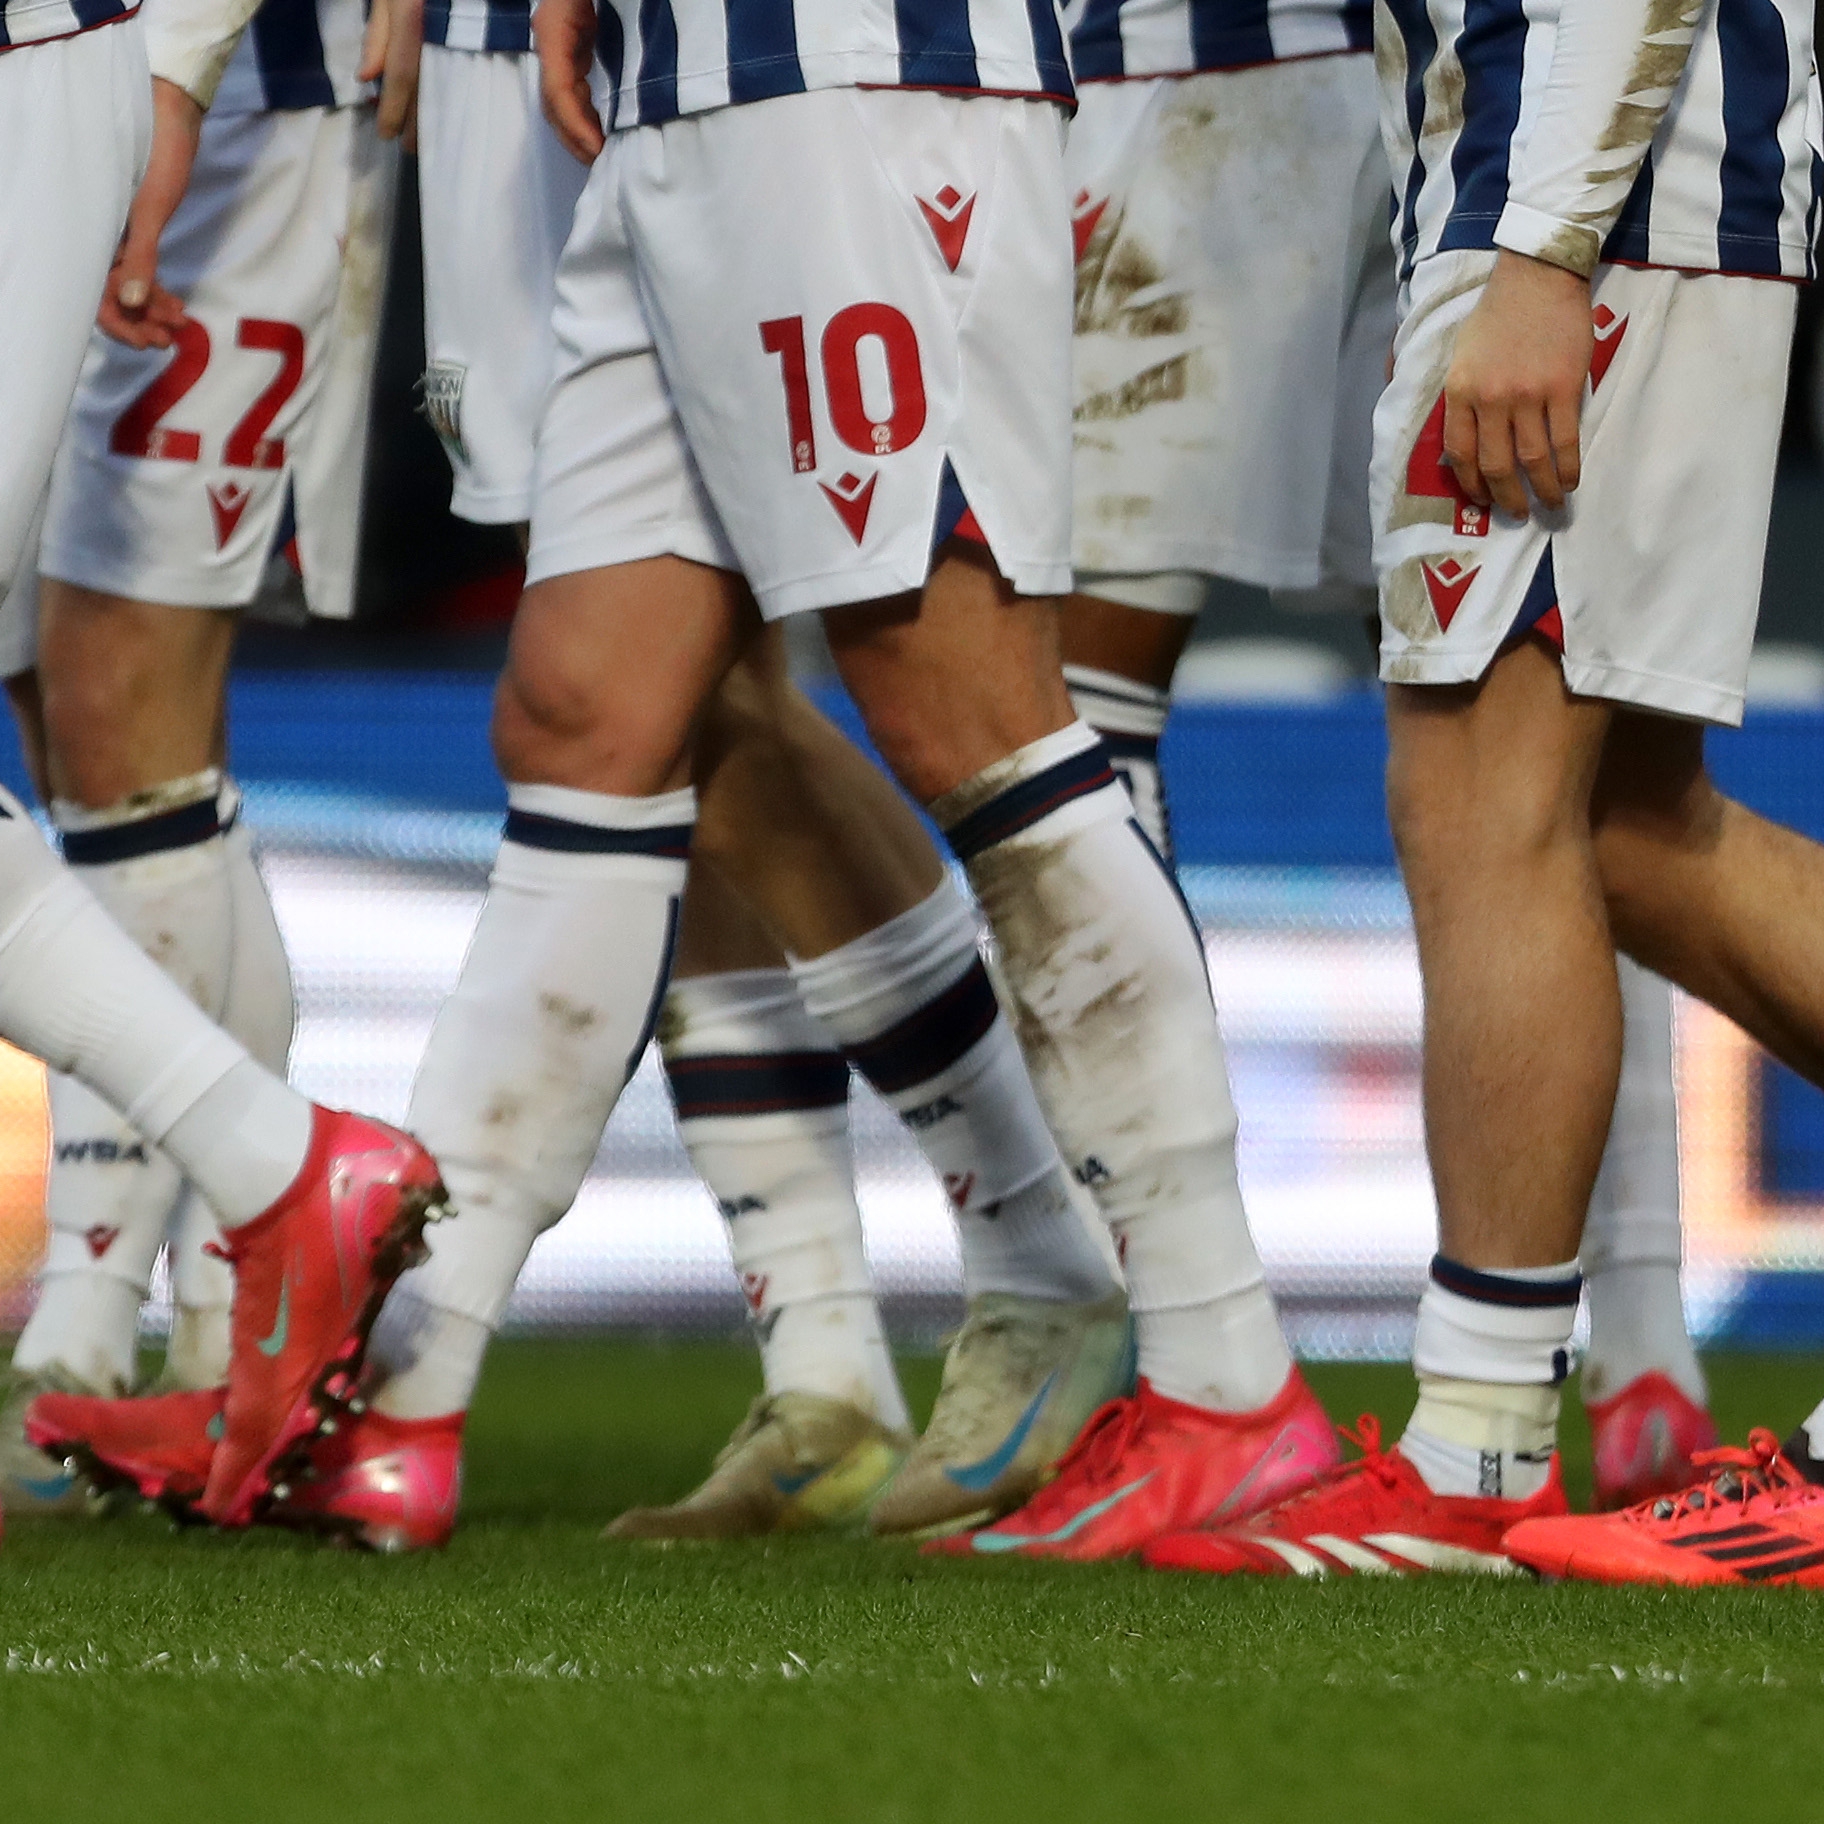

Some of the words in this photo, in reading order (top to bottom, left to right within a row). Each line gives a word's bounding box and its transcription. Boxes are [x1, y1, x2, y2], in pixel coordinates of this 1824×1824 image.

[108, 318, 304, 469] 22
[759, 302, 926, 473] 10
[1462, 524, 1478, 535] EFL
